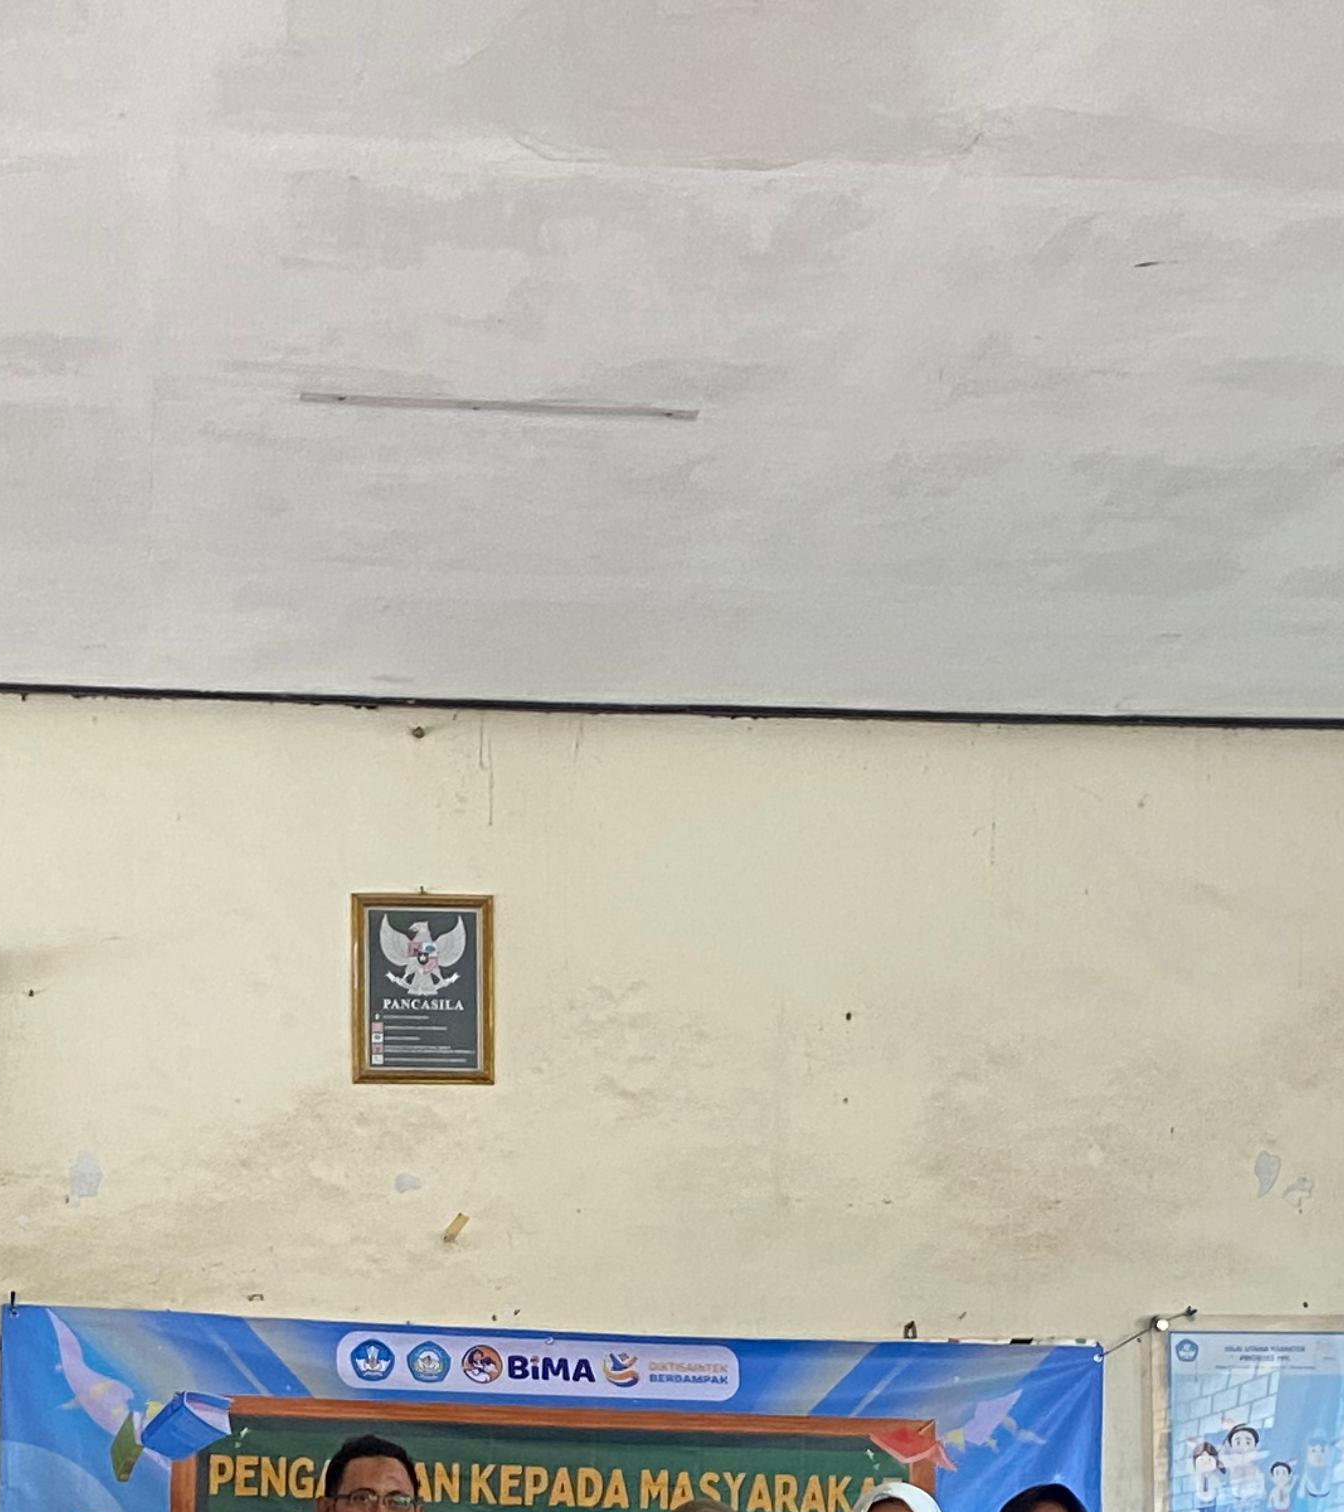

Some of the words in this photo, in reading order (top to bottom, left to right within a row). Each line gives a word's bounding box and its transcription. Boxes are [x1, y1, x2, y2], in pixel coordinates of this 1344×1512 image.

[383, 998, 465, 1011] PANCASILA
[649, 1373, 729, 1384] BERDAMPAK
[208, 1454, 460, 1504] PENGAN
[470, 1463, 630, 1509] KEPADA
